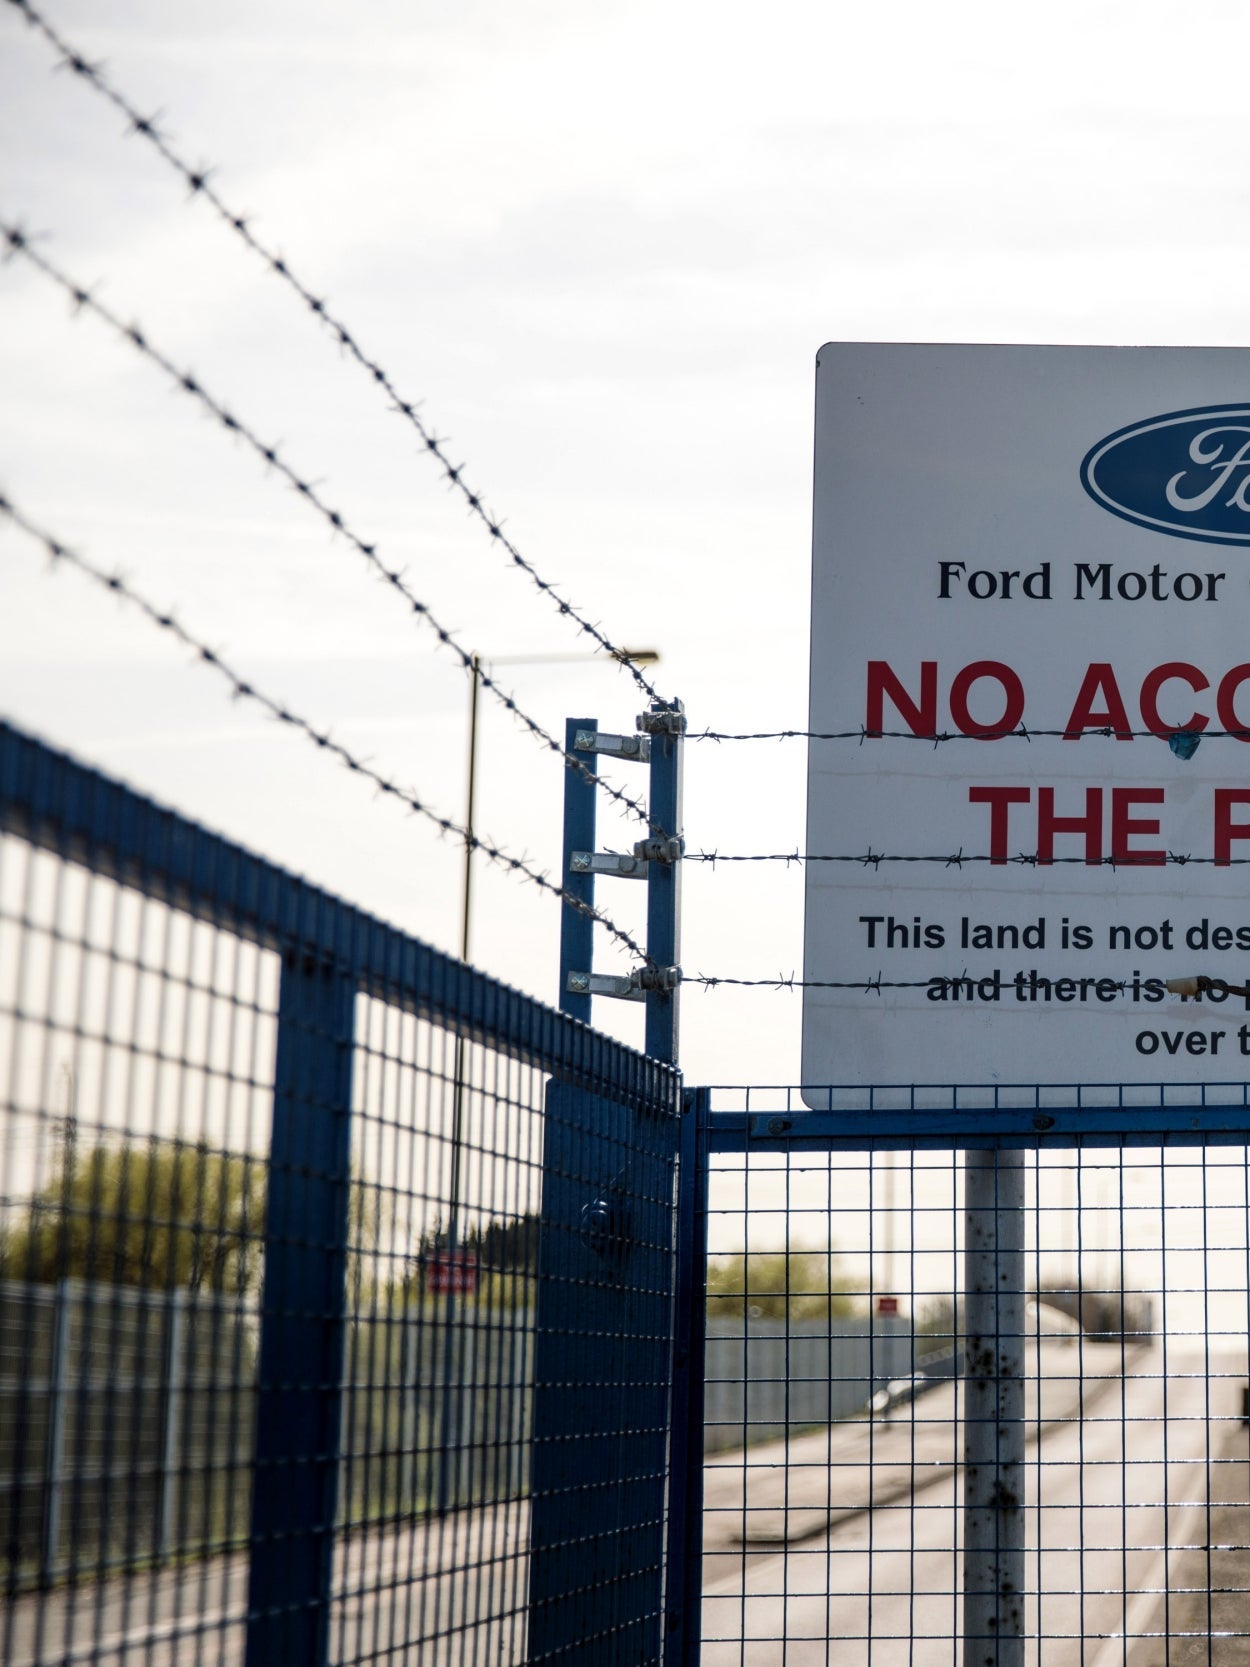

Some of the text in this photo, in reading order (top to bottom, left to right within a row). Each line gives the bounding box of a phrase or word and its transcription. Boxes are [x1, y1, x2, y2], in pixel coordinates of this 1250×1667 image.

[938, 562, 1052, 601] Ford
[1074, 563, 1226, 602] Motor
[866, 660, 1025, 740] NO
[969, 787, 1165, 866] THE
[859, 916, 945, 949] This
[961, 916, 1046, 950] land
[1061, 917, 1094, 950] is
[1108, 920, 1174, 951] not
[926, 969, 1002, 1002] and
[1014, 970, 1117, 1002] there
[1132, 970, 1165, 1002] is
[1180, 977, 1231, 1002] o
[1135, 1030, 1226, 1056] over
